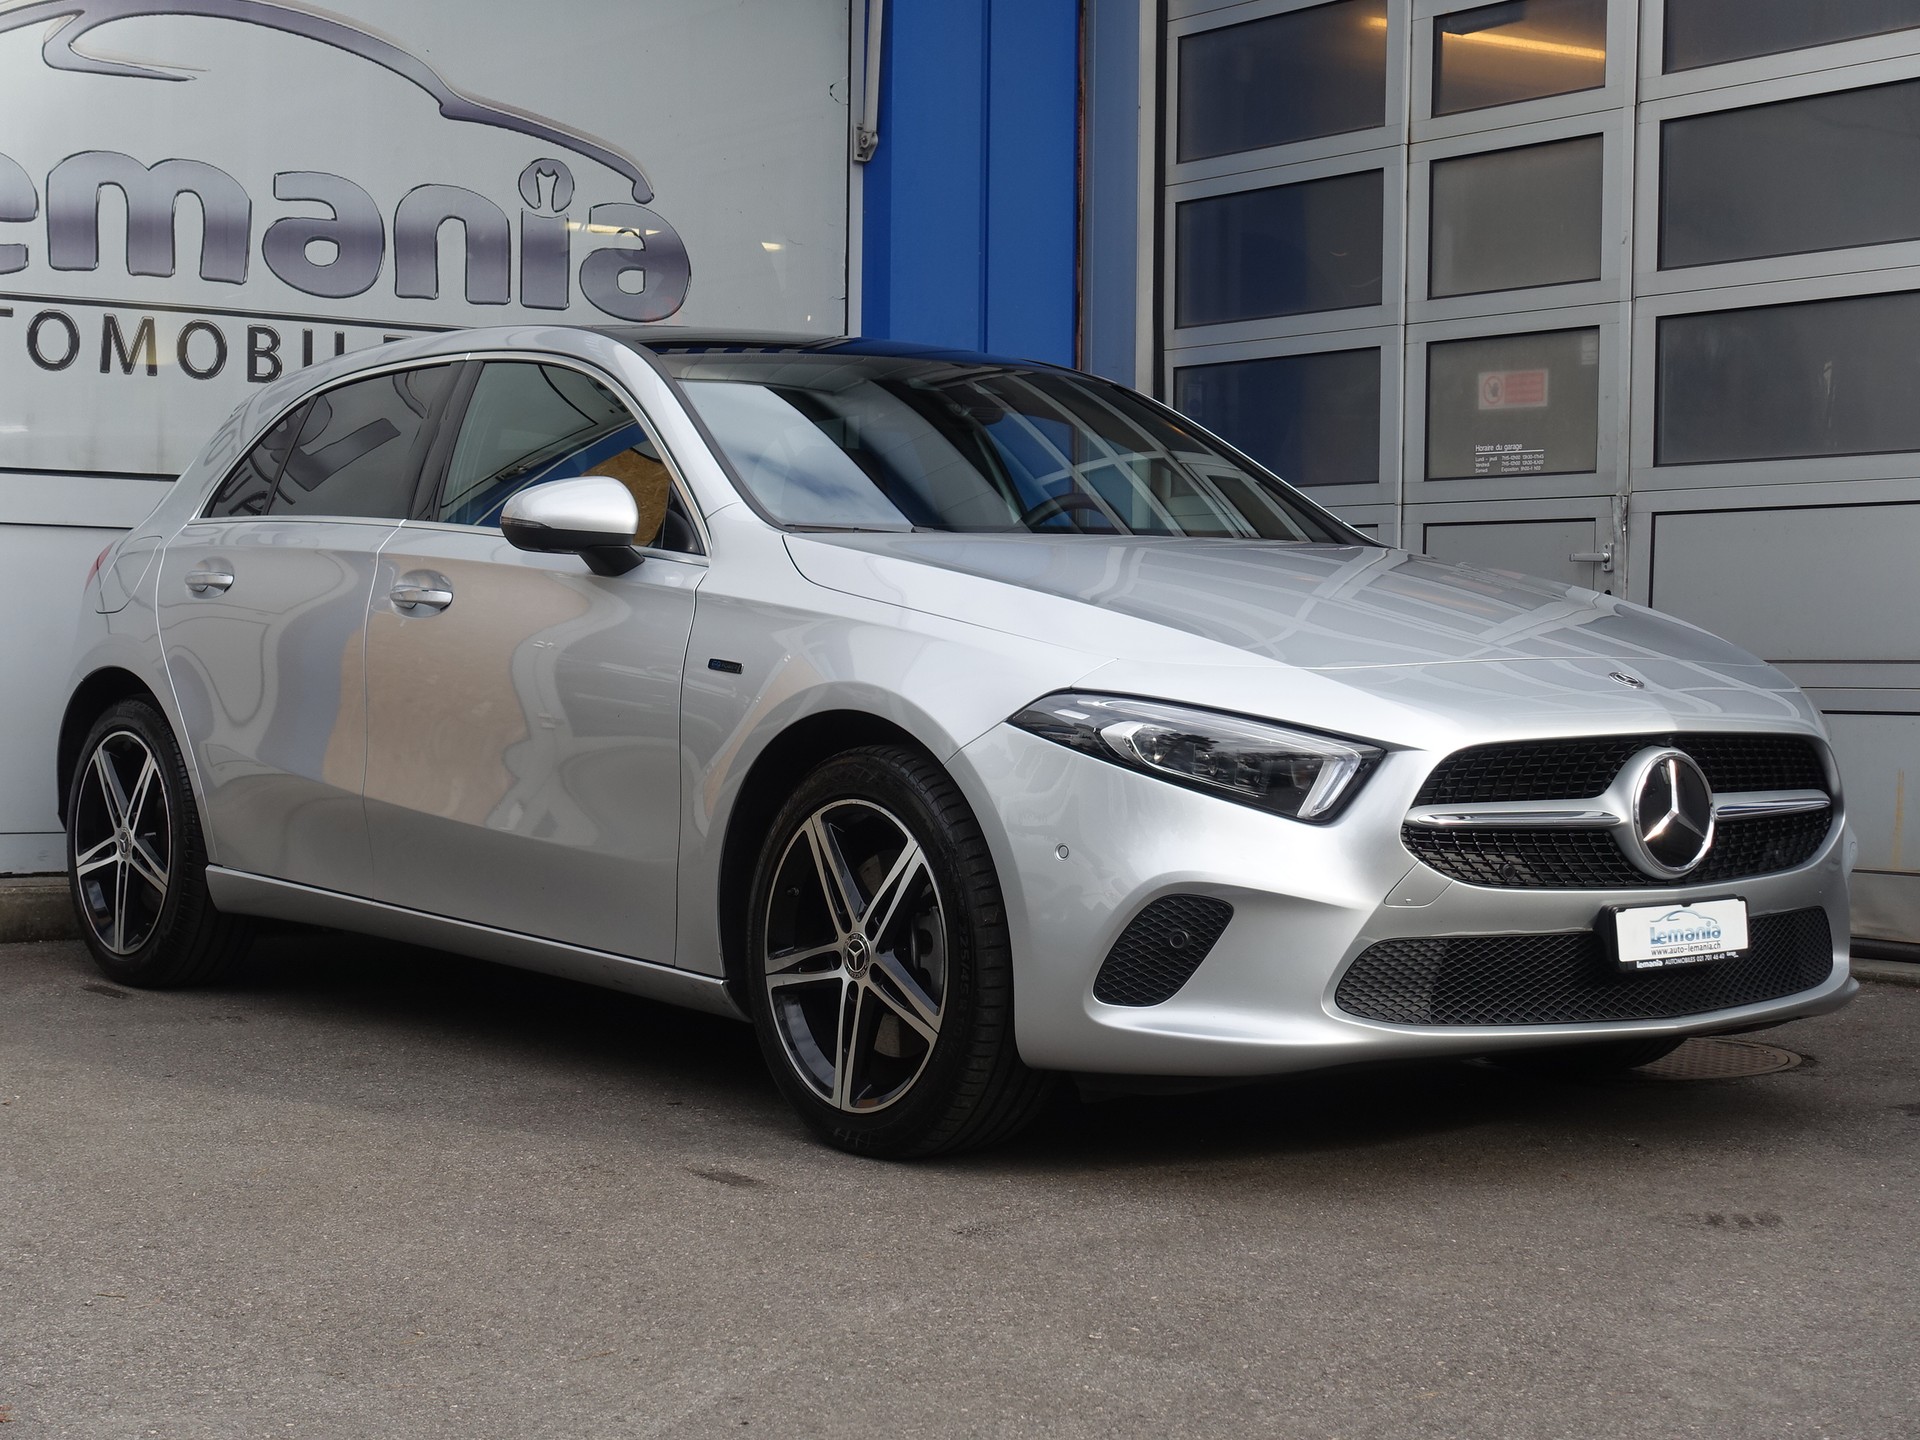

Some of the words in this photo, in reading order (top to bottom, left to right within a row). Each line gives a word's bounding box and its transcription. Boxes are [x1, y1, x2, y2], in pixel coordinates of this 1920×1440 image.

[1504, 444, 1522, 452] garage
[1650, 921, 1721, 944] Lemania
[1651, 942, 1721, 956] www.auto-lemania.ch
[1665, 957, 1696, 965] AUTOMOBILES
